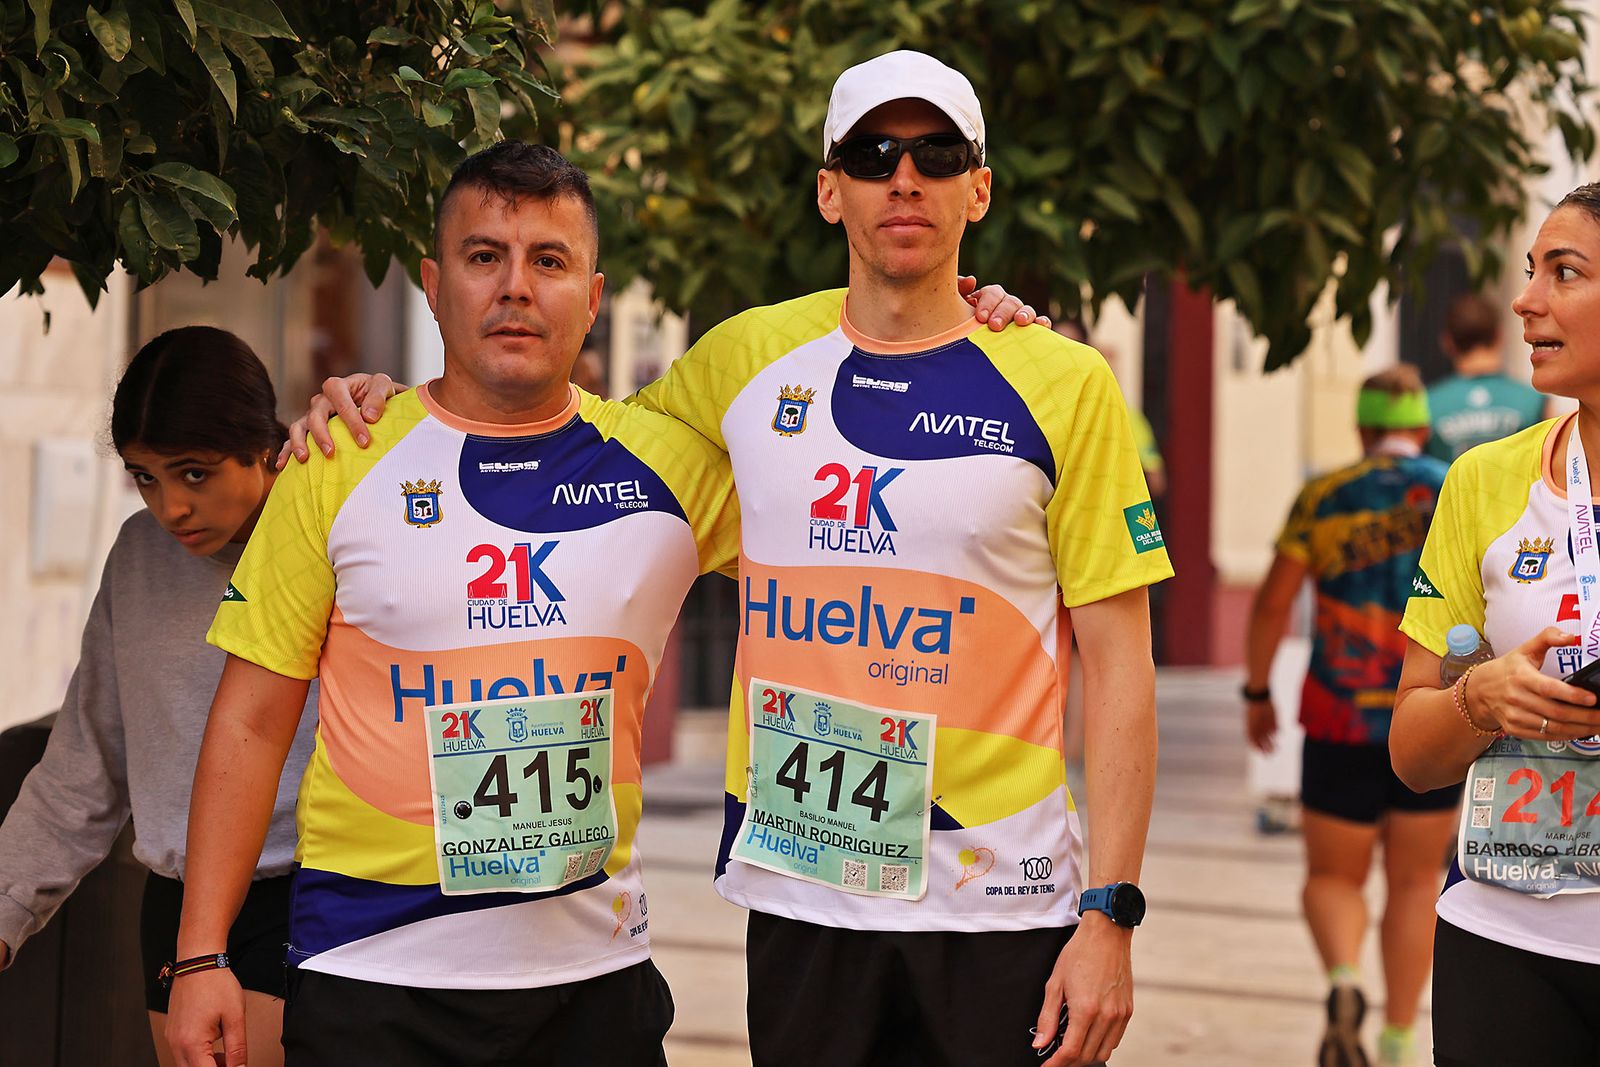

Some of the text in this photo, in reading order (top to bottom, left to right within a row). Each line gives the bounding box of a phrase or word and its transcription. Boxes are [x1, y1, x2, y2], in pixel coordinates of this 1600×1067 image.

[908, 411, 1015, 445] AVATEL
[973, 438, 1014, 454] TELECOM
[1572, 456, 1582, 486] Huelva
[551, 480, 649, 506] AVATEL
[613, 500, 649, 510] TELECOM
[810, 462, 906, 532] 21K
[809, 518, 847, 529] CIUDAD DE
[1575, 504, 1593, 555] AVATEL
[808, 525, 897, 556] HUELVA
[465, 540, 567, 605] 21K
[497, 598, 508, 606] DE
[467, 603, 567, 630] HUELVA
[744, 576, 954, 656] Huelva
[867, 657, 949, 687] original
[579, 697, 605, 728] 21K
[762, 688, 796, 722] 21K
[441, 708, 485, 740] 21K
[531, 726, 565, 737] HUELVA
[580, 726, 605, 740] HUELVA
[762, 713, 795, 732] HUELVA
[832, 727, 863, 742] HUELVA
[879, 716, 920, 751] 21K
[443, 739, 487, 753] HUELVA
[879, 743, 918, 760] HUELVA
[472, 747, 593, 818] 415
[775, 741, 890, 823] 414
[512, 817, 573, 831] MANUEL JESUS
[752, 808, 909, 859] MARTIN RODRIGUEZ
[799, 810, 857, 832] BASILIO MANUEL
[443, 834, 543, 856] GONZALEZ
[548, 825, 610, 847] GALLEGO
[746, 824, 818, 864] Huelva
[1466, 841, 1559, 858] BARROSO
[449, 853, 541, 878] Huelva
[793, 862, 818, 876] original
[1473, 858, 1556, 881] Huelva
[510, 876, 542, 886] original
[985, 884, 1056, 896] COPA DEL REY DE TENIS
[1526, 880, 1557, 891] original
